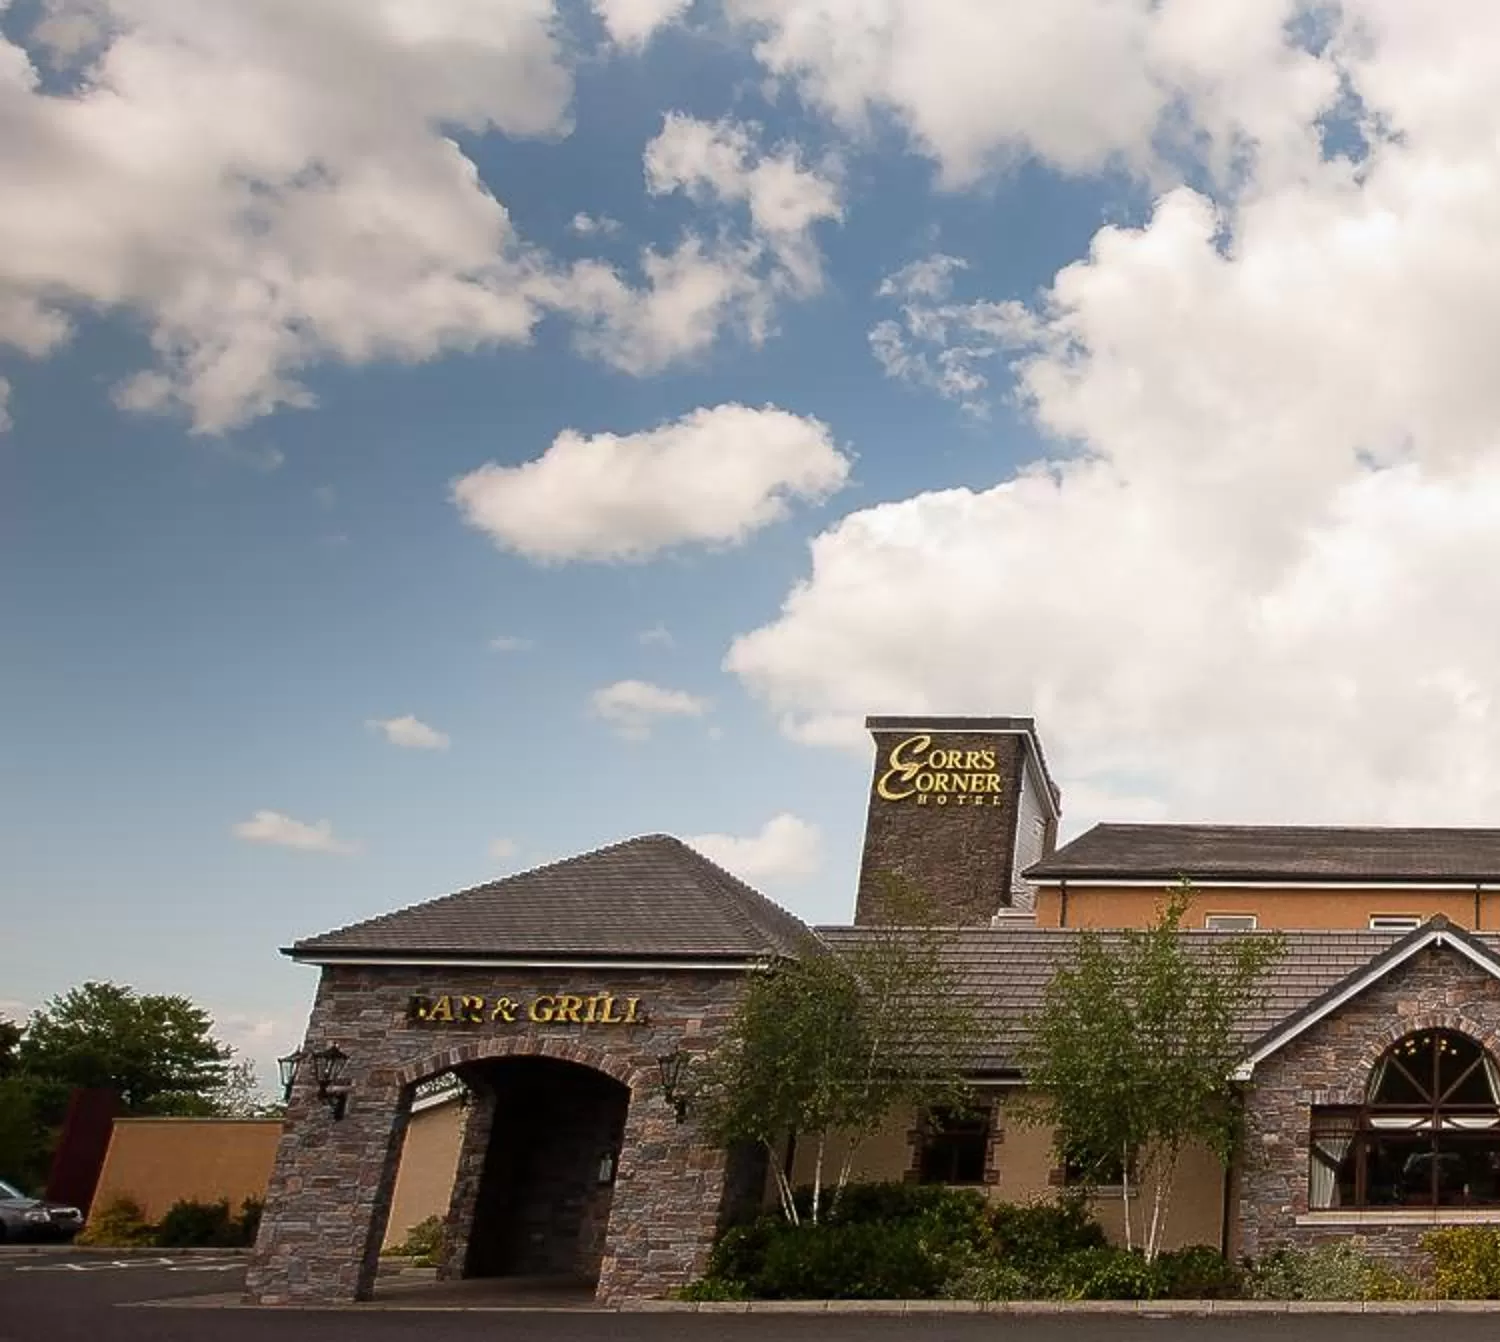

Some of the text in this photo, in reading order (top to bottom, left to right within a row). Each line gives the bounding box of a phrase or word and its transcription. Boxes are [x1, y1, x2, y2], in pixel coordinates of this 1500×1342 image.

[889, 735, 996, 771] CORR'S
[877, 764, 1002, 800] CORNER
[917, 795, 1001, 805] HOTEL
[491, 997, 518, 1022] &
